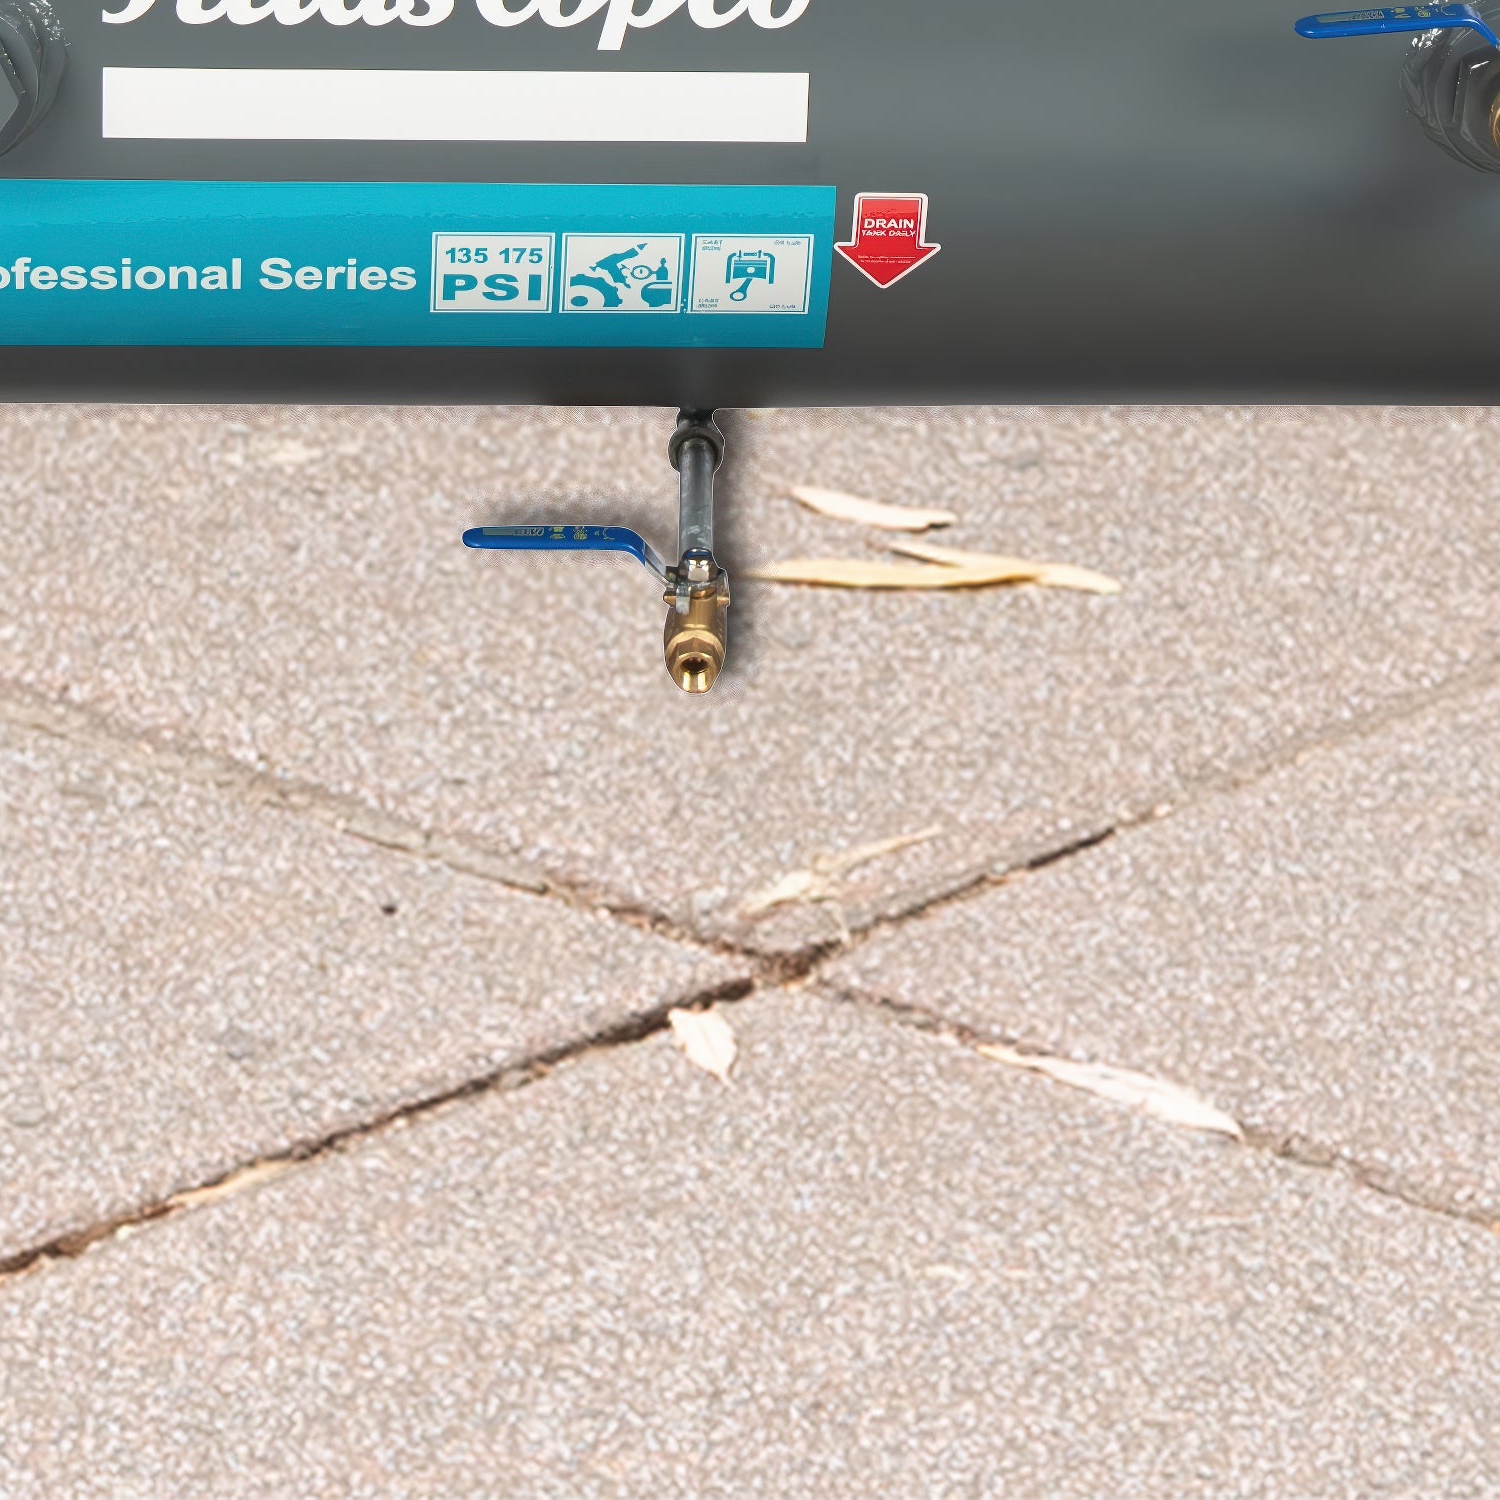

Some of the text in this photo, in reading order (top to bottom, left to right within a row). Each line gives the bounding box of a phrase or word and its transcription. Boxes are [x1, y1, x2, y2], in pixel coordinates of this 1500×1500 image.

[864, 219, 914, 228] DRAIN
[446, 248, 543, 263] 135 175
[259, 258, 417, 291] Series
[443, 274, 542, 301] PSI
